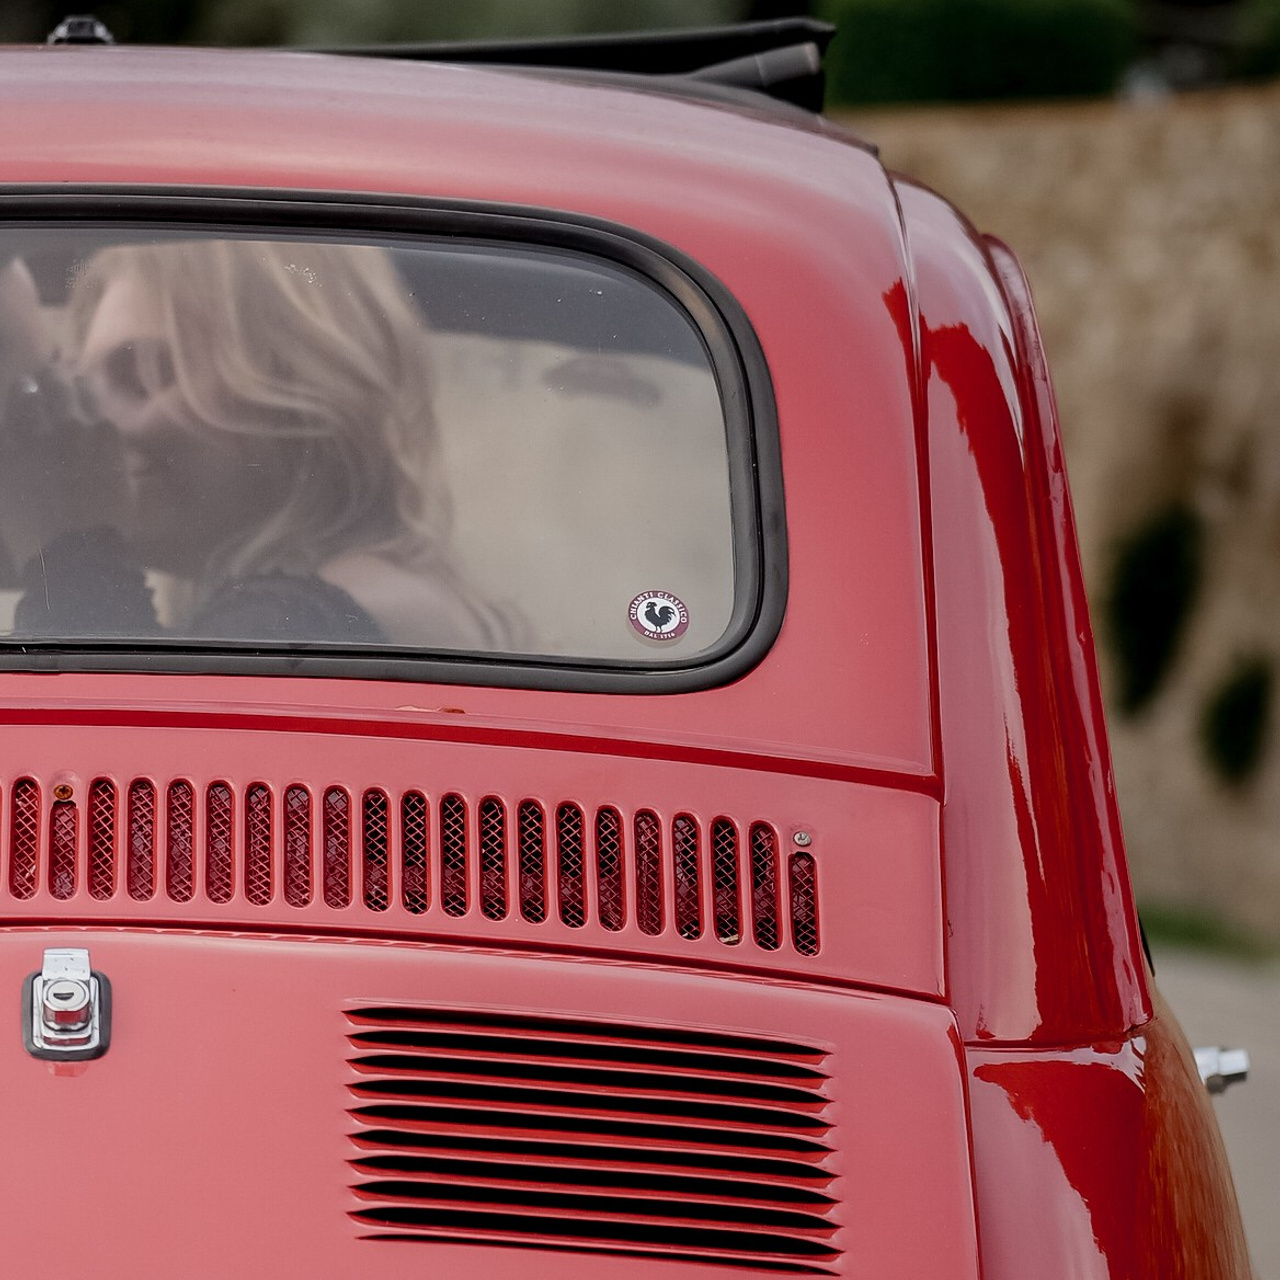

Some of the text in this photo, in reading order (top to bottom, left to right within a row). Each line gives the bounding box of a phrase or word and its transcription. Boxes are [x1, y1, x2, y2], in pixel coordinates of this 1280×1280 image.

[630, 592, 687, 623] CHIANTI CLASSICO
[644, 630, 658, 639] DAL
